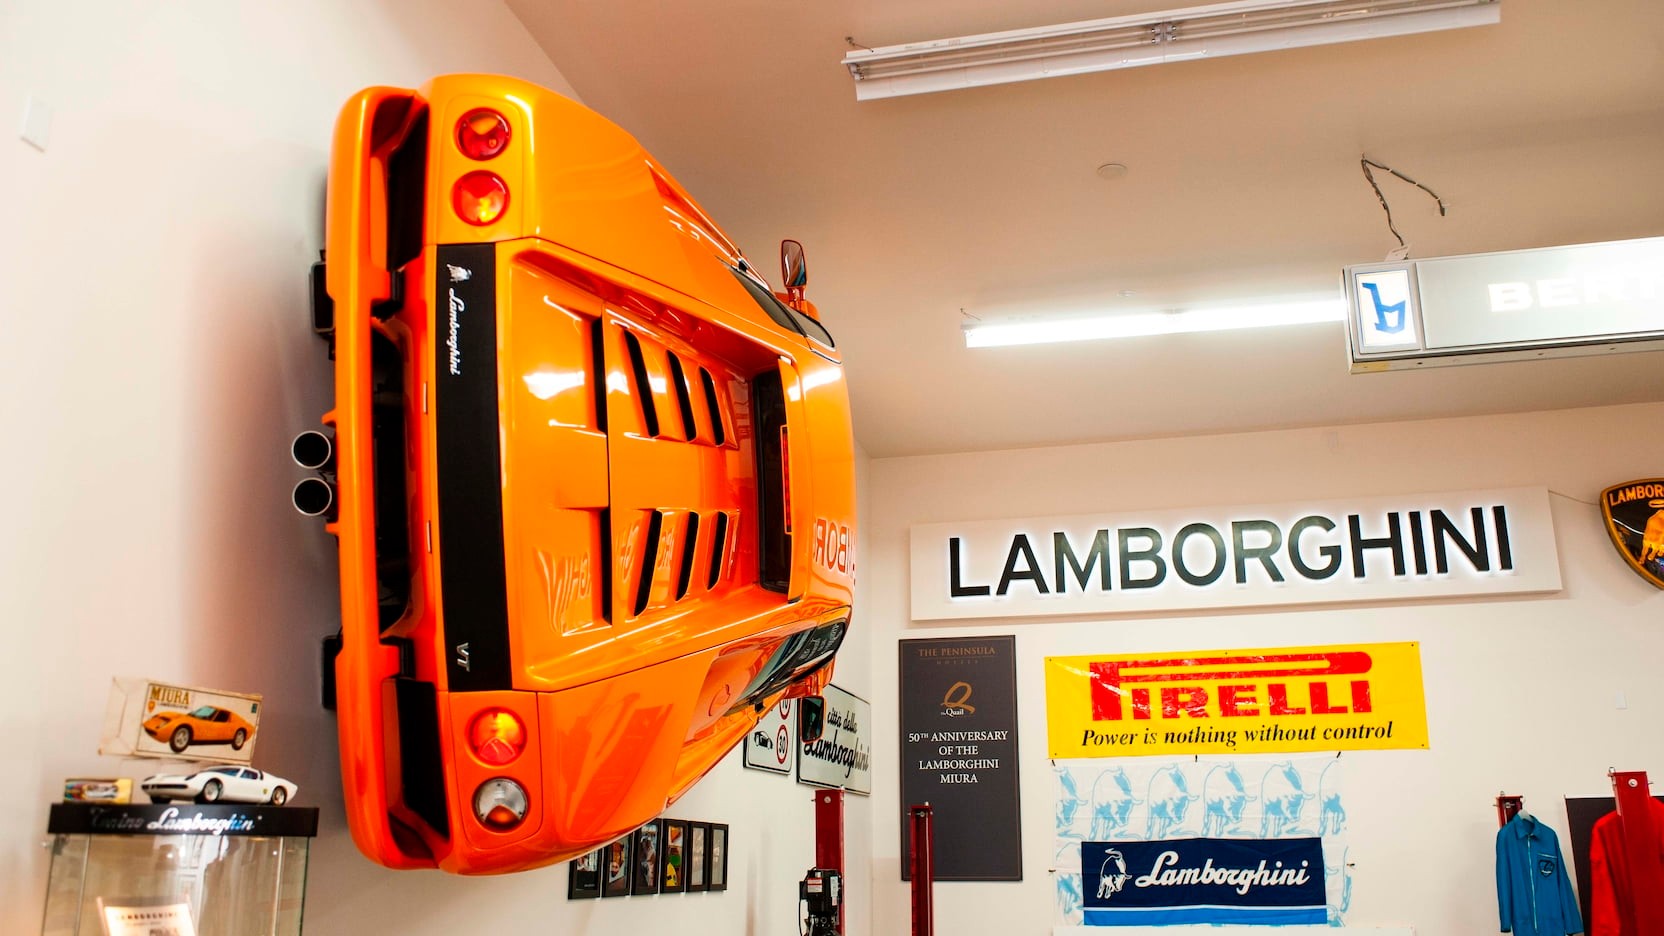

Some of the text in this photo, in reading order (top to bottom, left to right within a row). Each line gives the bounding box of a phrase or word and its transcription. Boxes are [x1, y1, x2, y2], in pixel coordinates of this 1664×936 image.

[446, 287, 465, 375] Lamborghini
[1609, 484, 1664, 506] LAMBOR
[948, 505, 1513, 598] LAMBORGHINI
[456, 642, 470, 672] VT
[919, 646, 996, 657] THE PENINSULA
[150, 686, 190, 705] MIURA
[1089, 651, 1373, 722] PIRELLI
[945, 708, 964, 718] Quail
[930, 730, 1008, 742] ANNIVERSARY
[1081, 720, 1394, 747] Power is nothing without control
[938, 745, 979, 755] OF THE
[919, 758, 1000, 770] LAMBORGHINI
[940, 774, 979, 784] MIURA
[1134, 850, 1312, 896] Lamborghini
